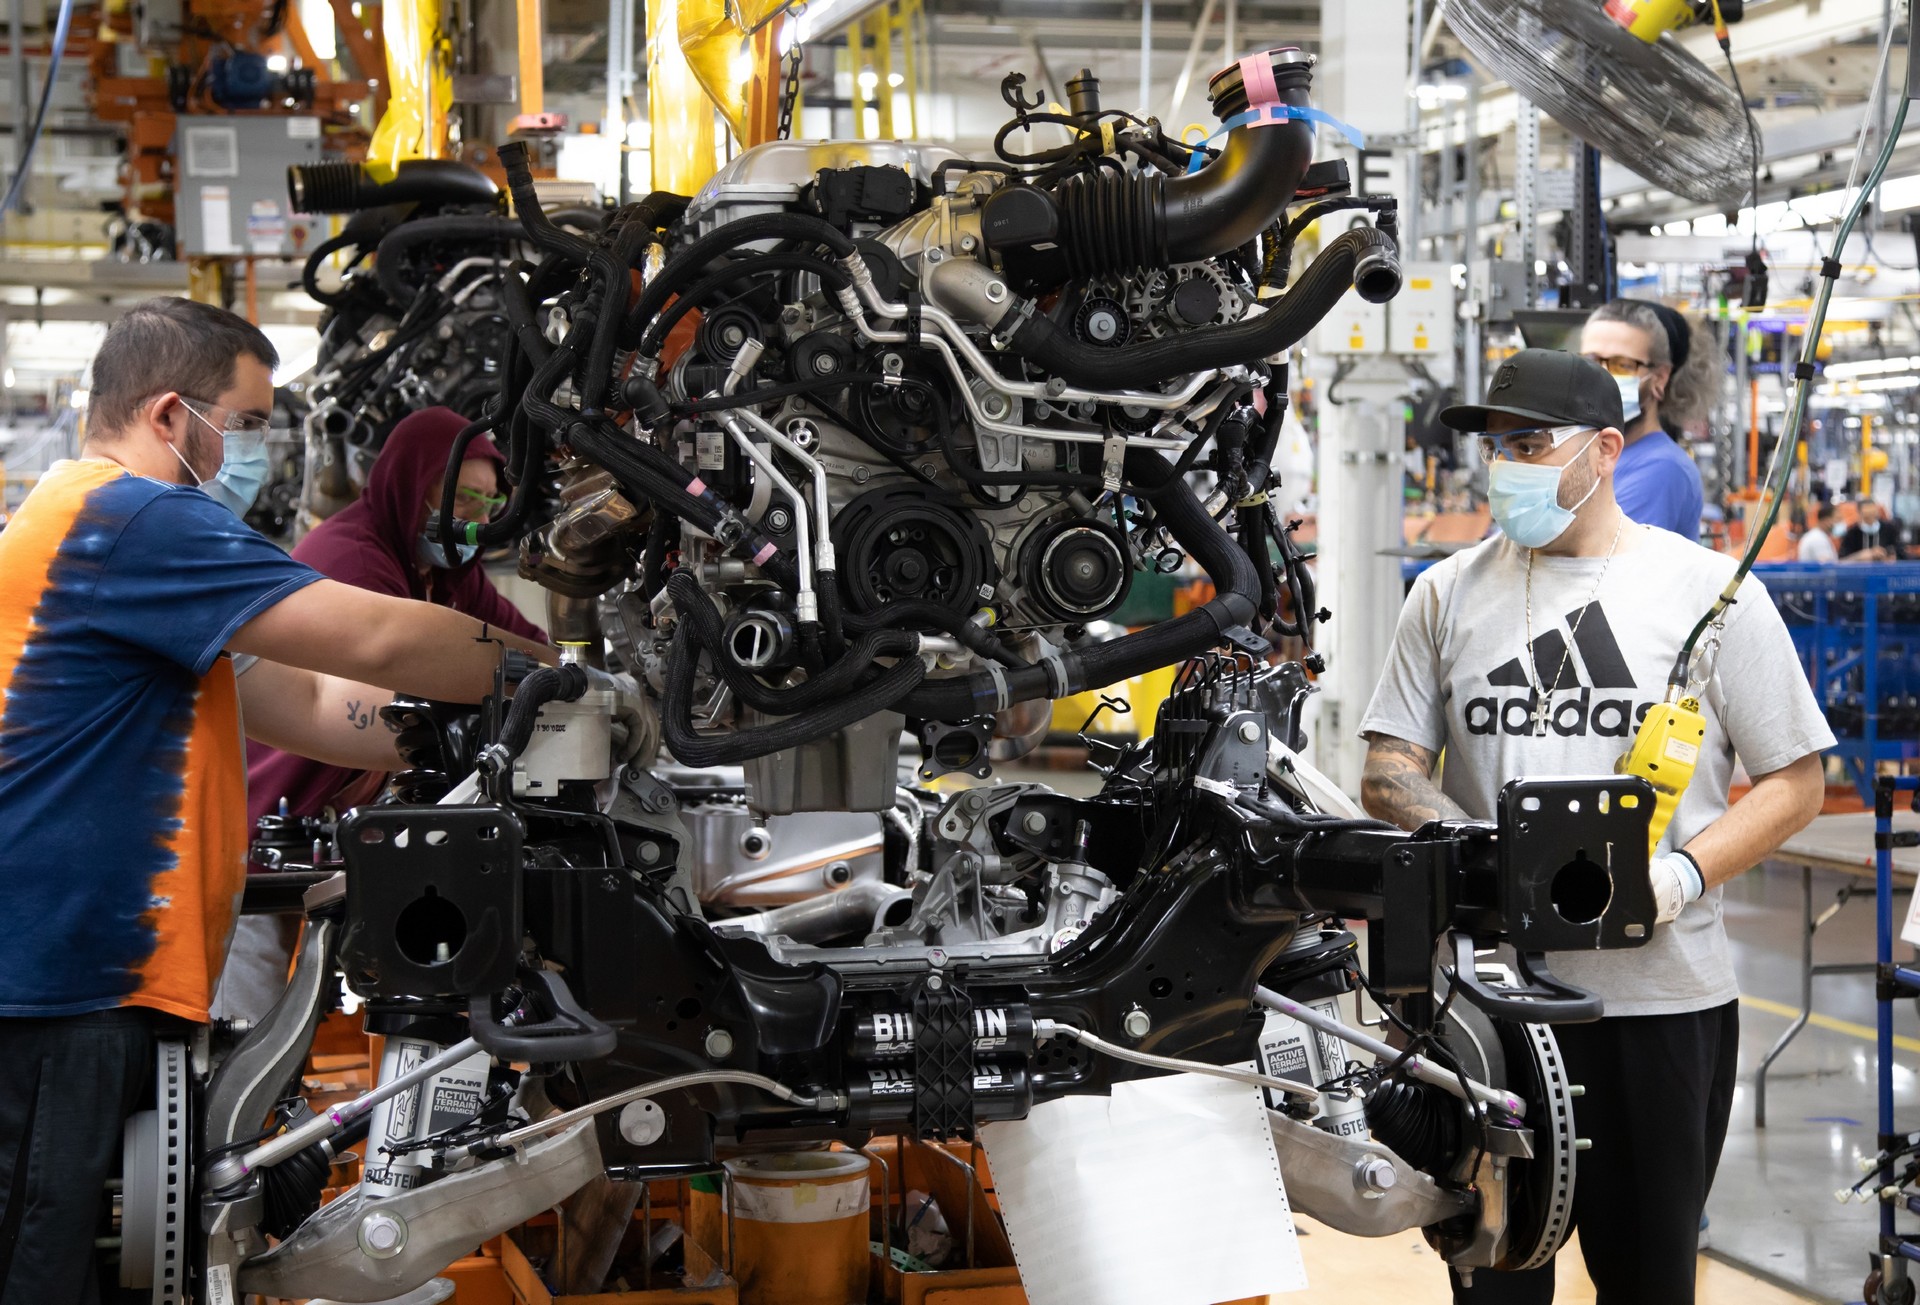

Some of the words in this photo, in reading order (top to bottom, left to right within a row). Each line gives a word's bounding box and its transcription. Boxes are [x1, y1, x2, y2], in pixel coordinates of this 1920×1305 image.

[1264, 1036, 1301, 1050] RAM
[1269, 1048, 1304, 1064] ACTIVE
[1270, 1056, 1306, 1070] TERRAIN
[1272, 1063, 1307, 1076] DYNAMICS
[439, 1076, 482, 1088] RAM
[436, 1089, 478, 1102] ACTIVE
[433, 1105, 475, 1116] DYNAMICS
[435, 1099, 477, 1109] TERRAIN
